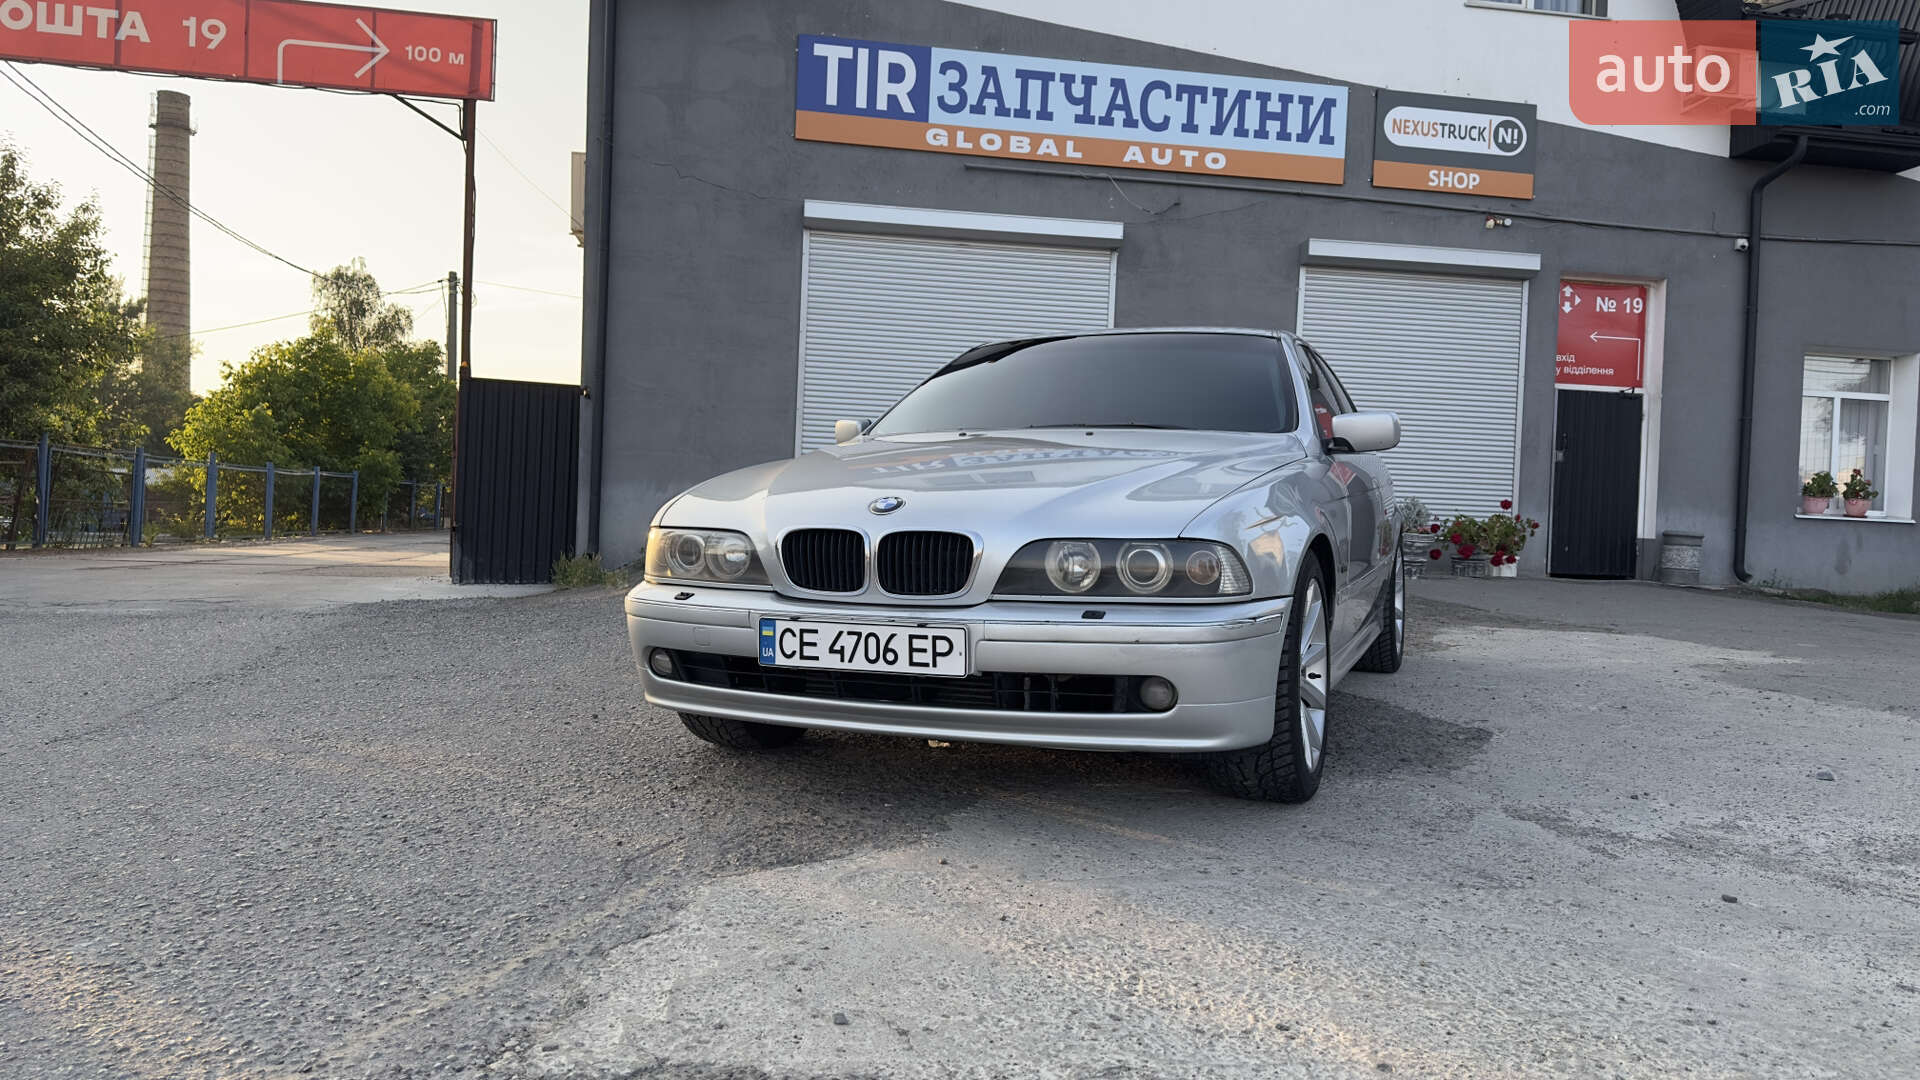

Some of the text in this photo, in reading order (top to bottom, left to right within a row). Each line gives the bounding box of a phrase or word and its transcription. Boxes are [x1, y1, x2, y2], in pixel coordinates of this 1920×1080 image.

[0, 0, 226, 50] ОШТА 19
[405, 44, 441, 63] 100
[813, 43, 1337, 145] TIR ЗАПЧАСТИНИ
[1392, 118, 1487, 142] NEXUSTRUCK
[925, 128, 1227, 169] GLOBAL AUTO
[1427, 170, 1480, 189] SHOP
[1623, 297, 1643, 314] 19
[763, 648, 774, 657] UA
[779, 627, 954, 668] CE 4706 EP
